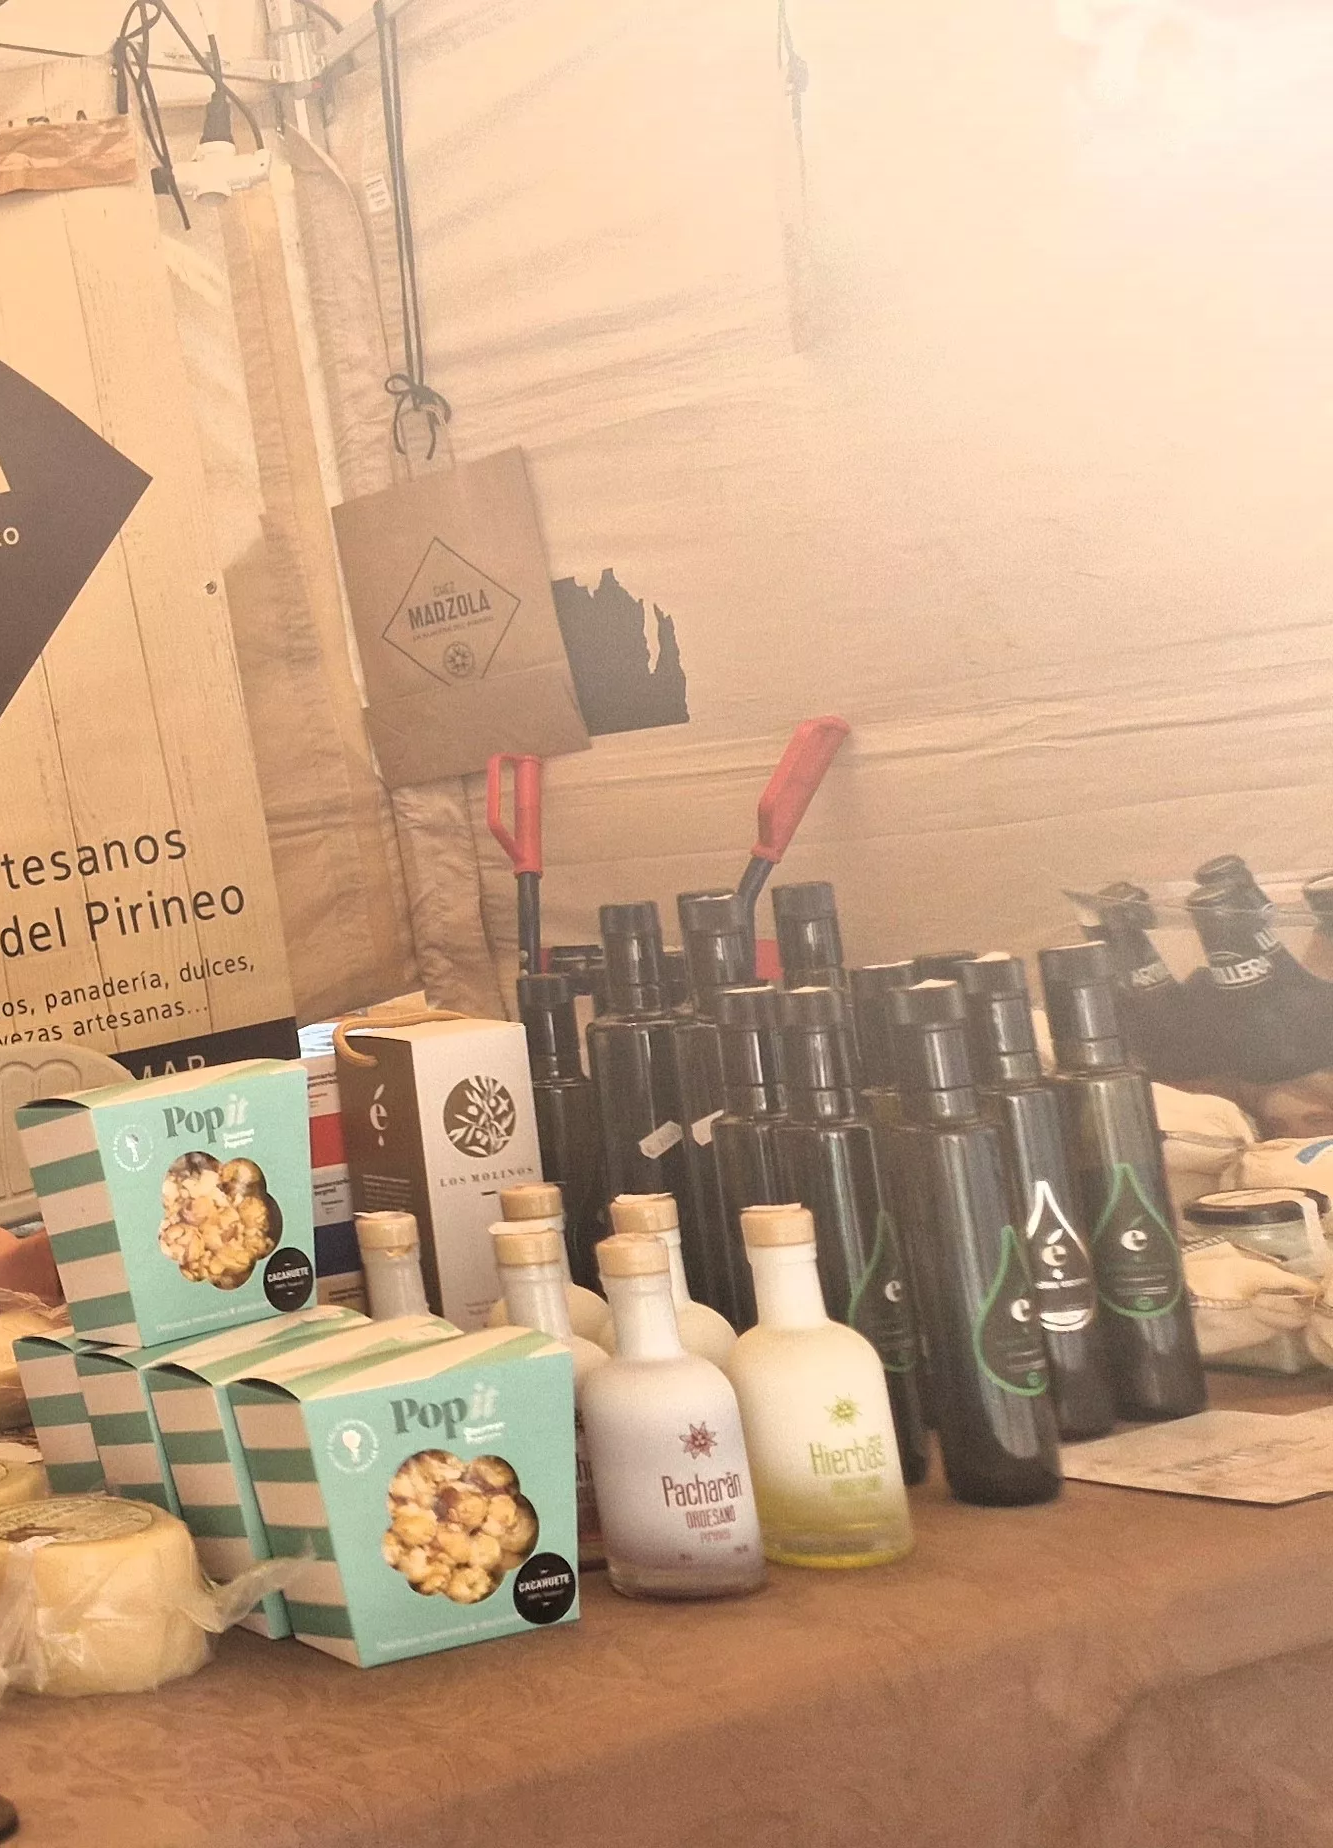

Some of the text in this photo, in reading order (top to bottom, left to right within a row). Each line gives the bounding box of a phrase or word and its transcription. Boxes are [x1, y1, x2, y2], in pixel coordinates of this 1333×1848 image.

[0, 907, 69, 961] del
[85, 881, 246, 946] Pirineo
[45, 969, 171, 1014] panadería,
[179, 952, 255, 984] dulces,
[439, 1166, 535, 1188] LOS MOLINOS
[517, 1573, 572, 1593] CACAHUETE
